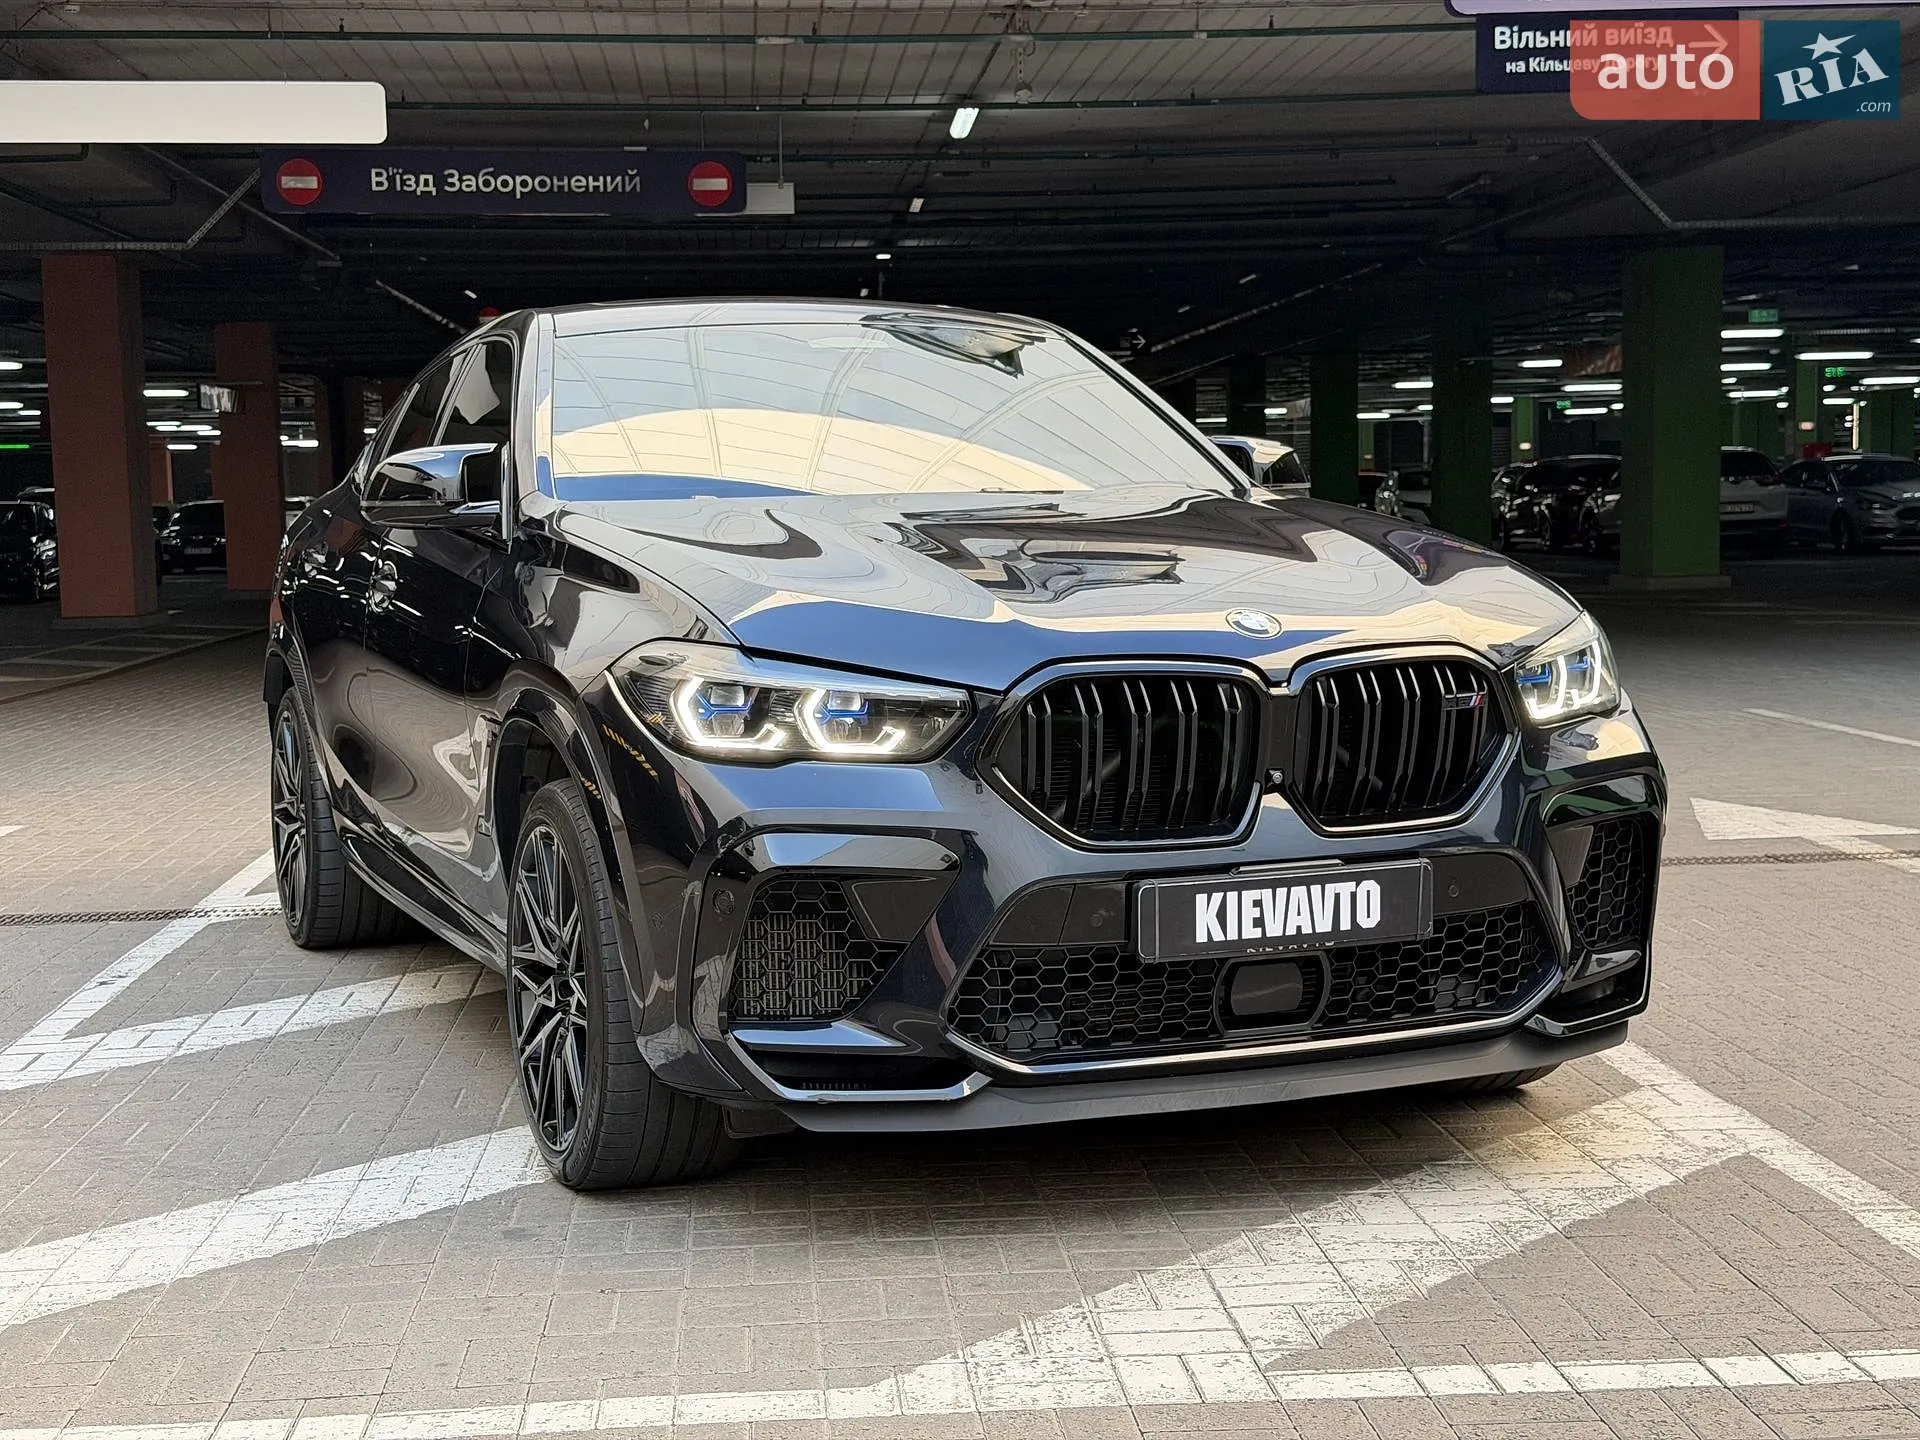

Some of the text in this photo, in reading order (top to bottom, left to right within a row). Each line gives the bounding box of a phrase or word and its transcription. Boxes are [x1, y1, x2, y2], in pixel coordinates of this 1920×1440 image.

[1494, 22, 1674, 50] Вільний виїзд
[1506, 62, 1526, 74] на
[1529, 57, 1600, 74] Кільцеву
[443, 167, 641, 199] Заборонений
